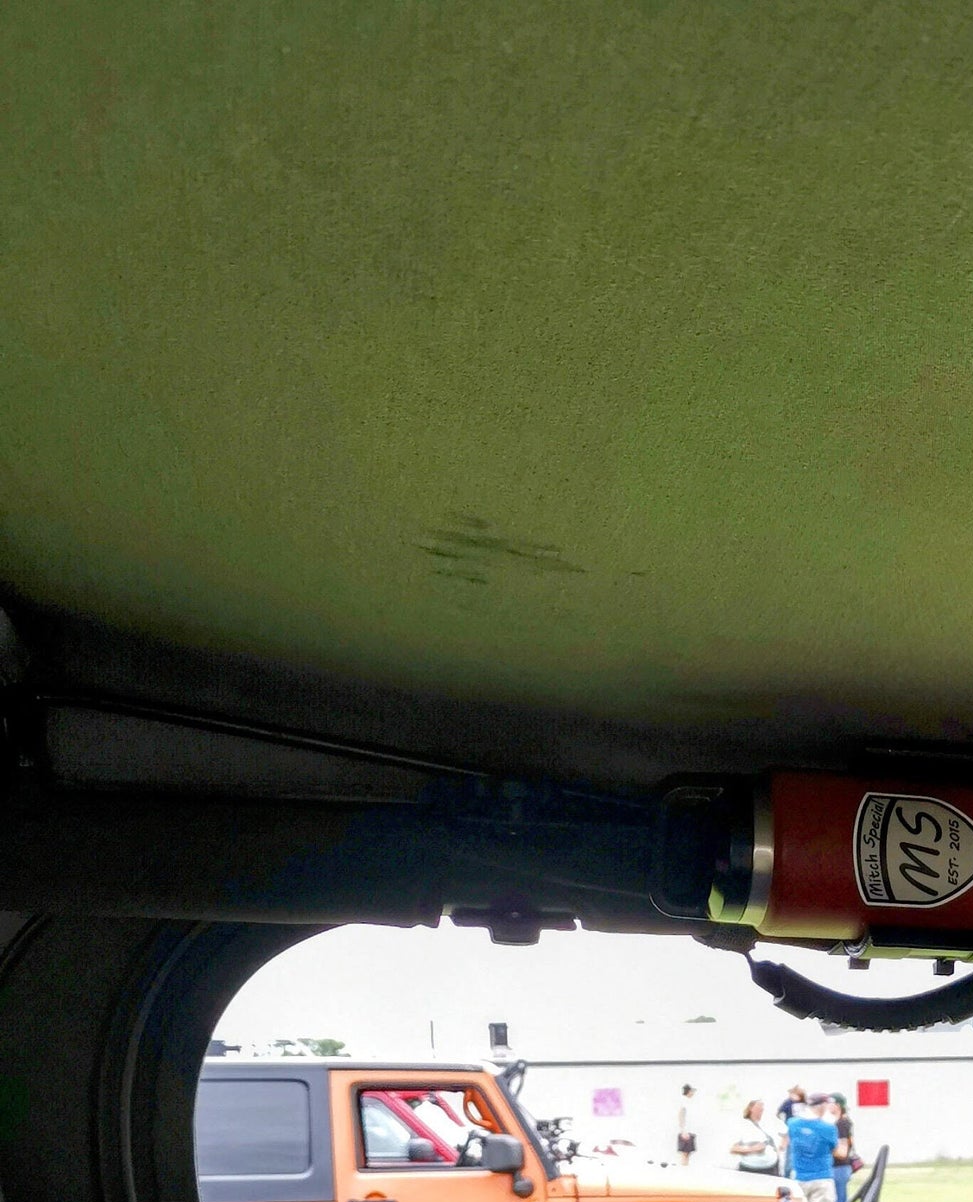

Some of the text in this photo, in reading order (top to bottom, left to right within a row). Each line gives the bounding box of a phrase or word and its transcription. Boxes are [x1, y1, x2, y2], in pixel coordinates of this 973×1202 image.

[863, 799, 884, 896] Mitch Special
[896, 807, 942, 896] MS
[948, 819, 960, 885] EST. 2015
